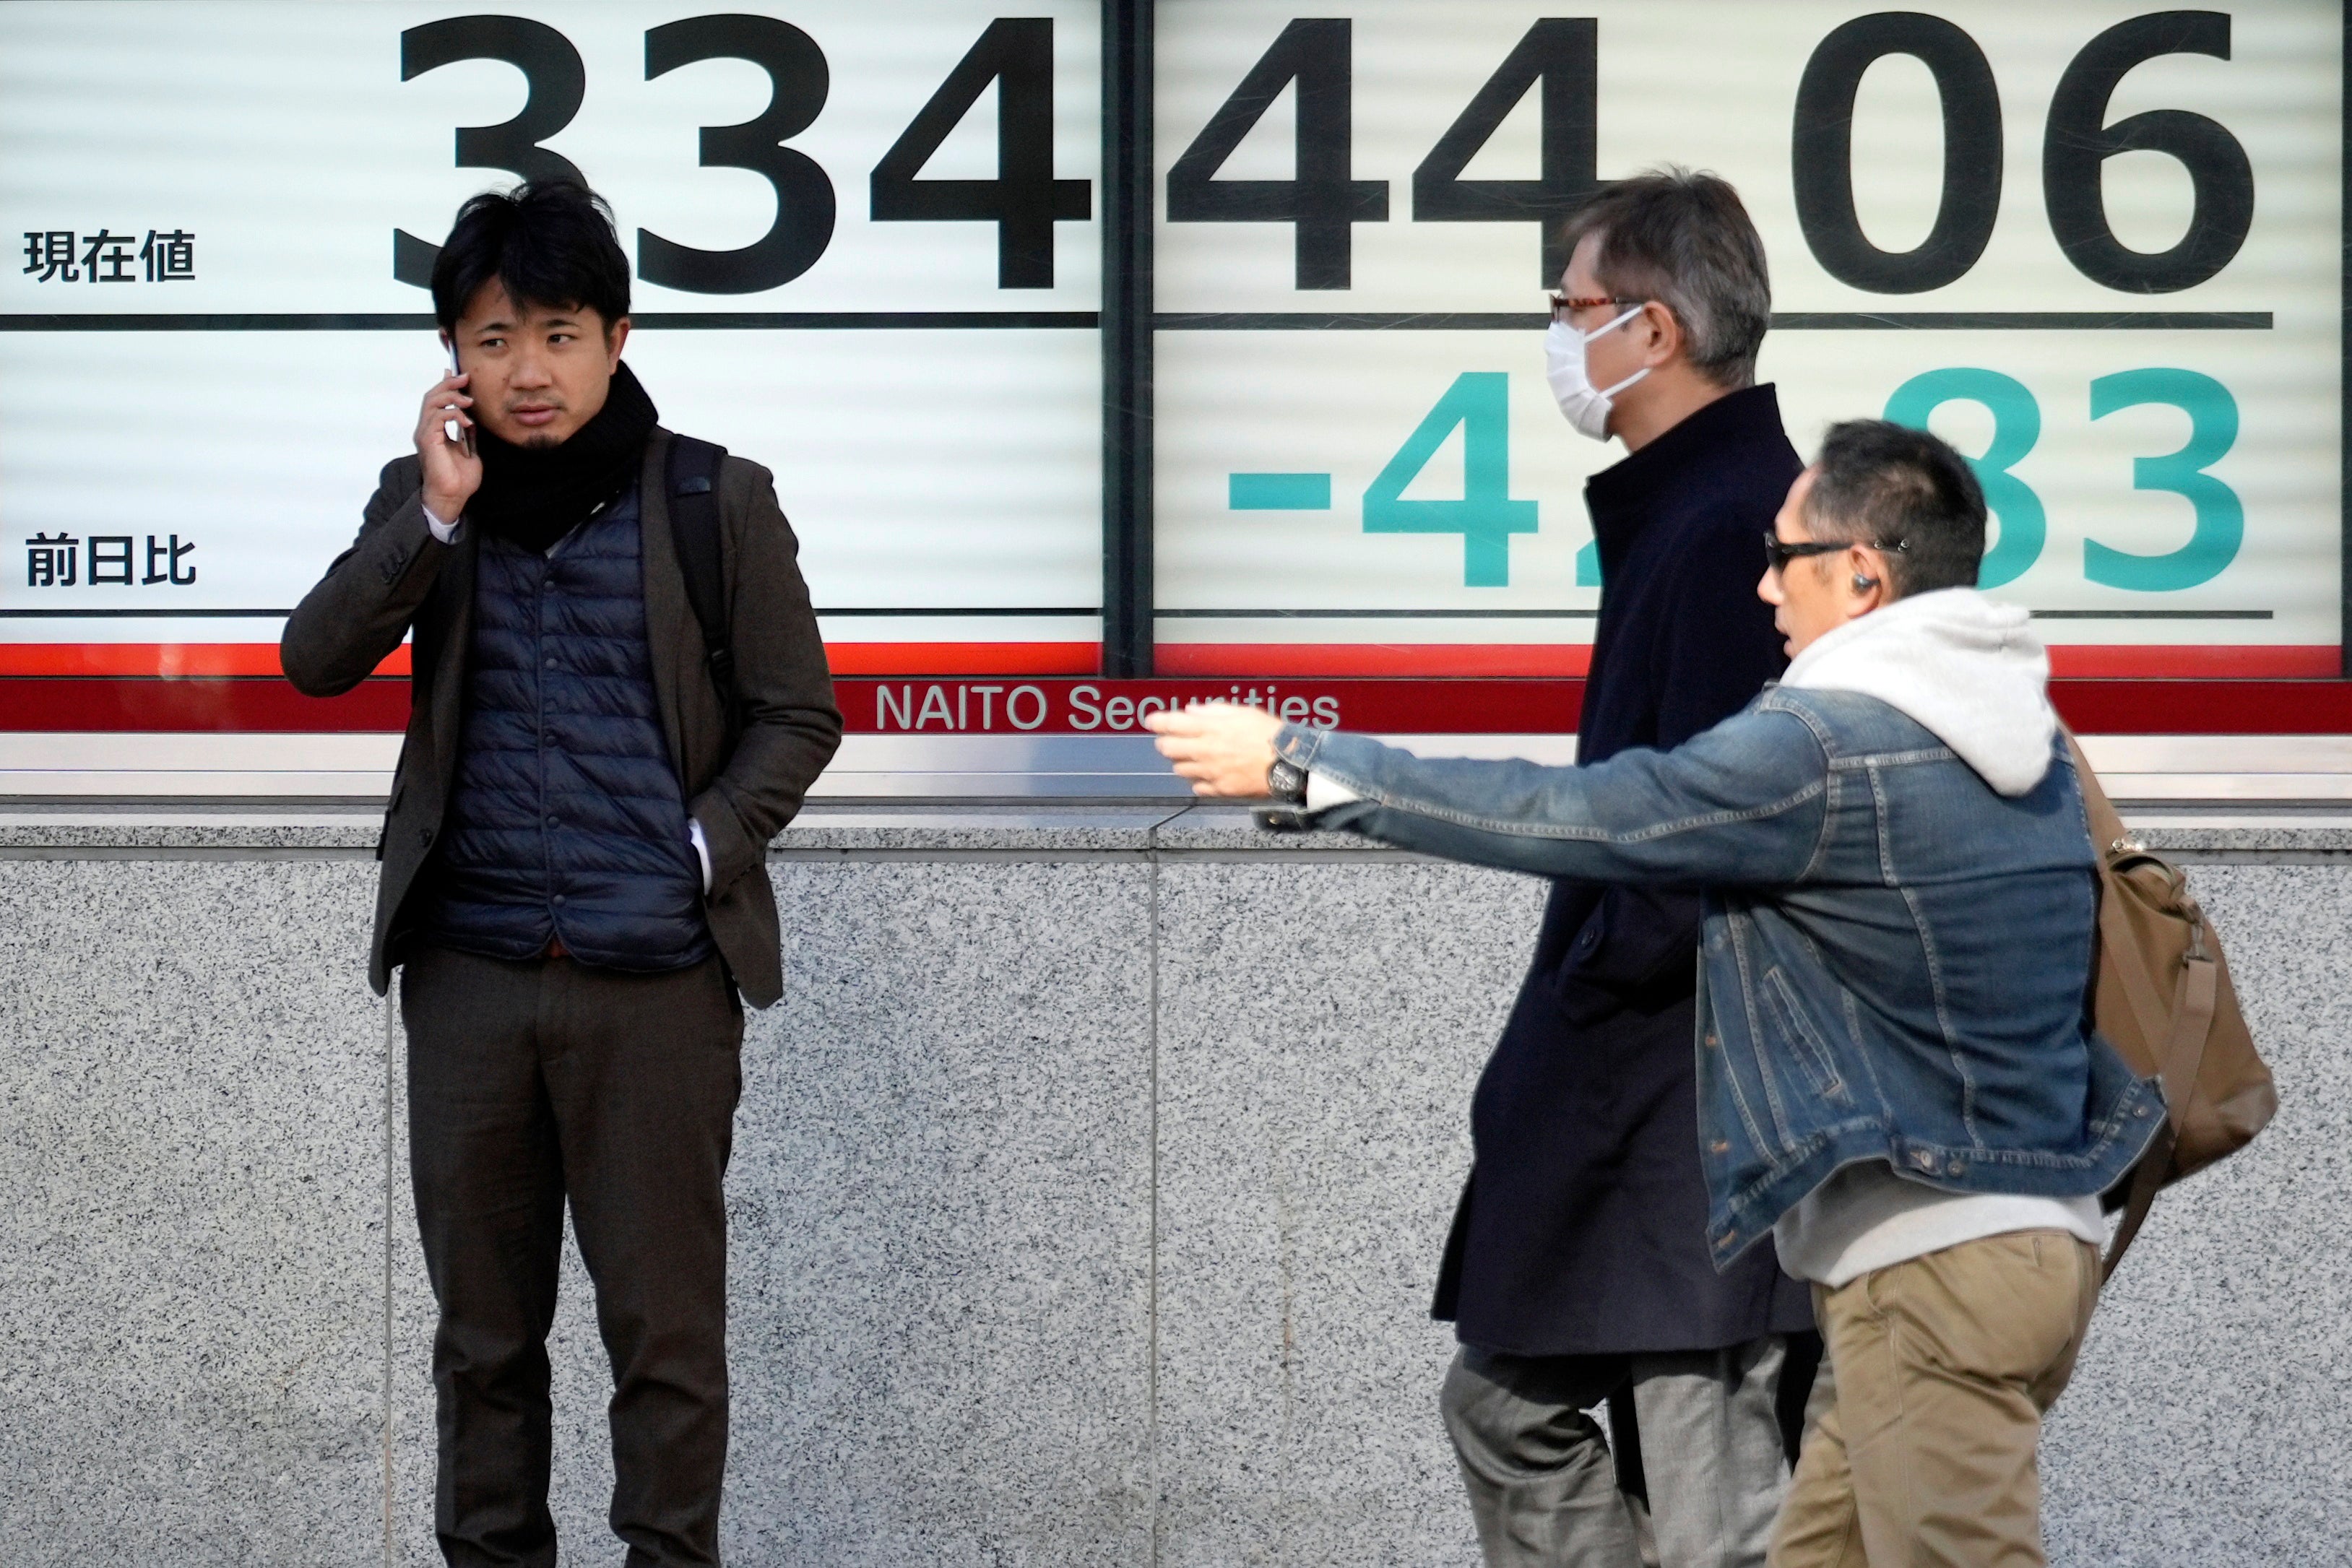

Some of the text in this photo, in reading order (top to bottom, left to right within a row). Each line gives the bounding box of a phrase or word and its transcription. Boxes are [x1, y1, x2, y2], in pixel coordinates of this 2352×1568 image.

[23, 229, 196, 282] 現在値
[25, 532, 196, 587] 前日比
[876, 685, 1047, 730] NAITO
